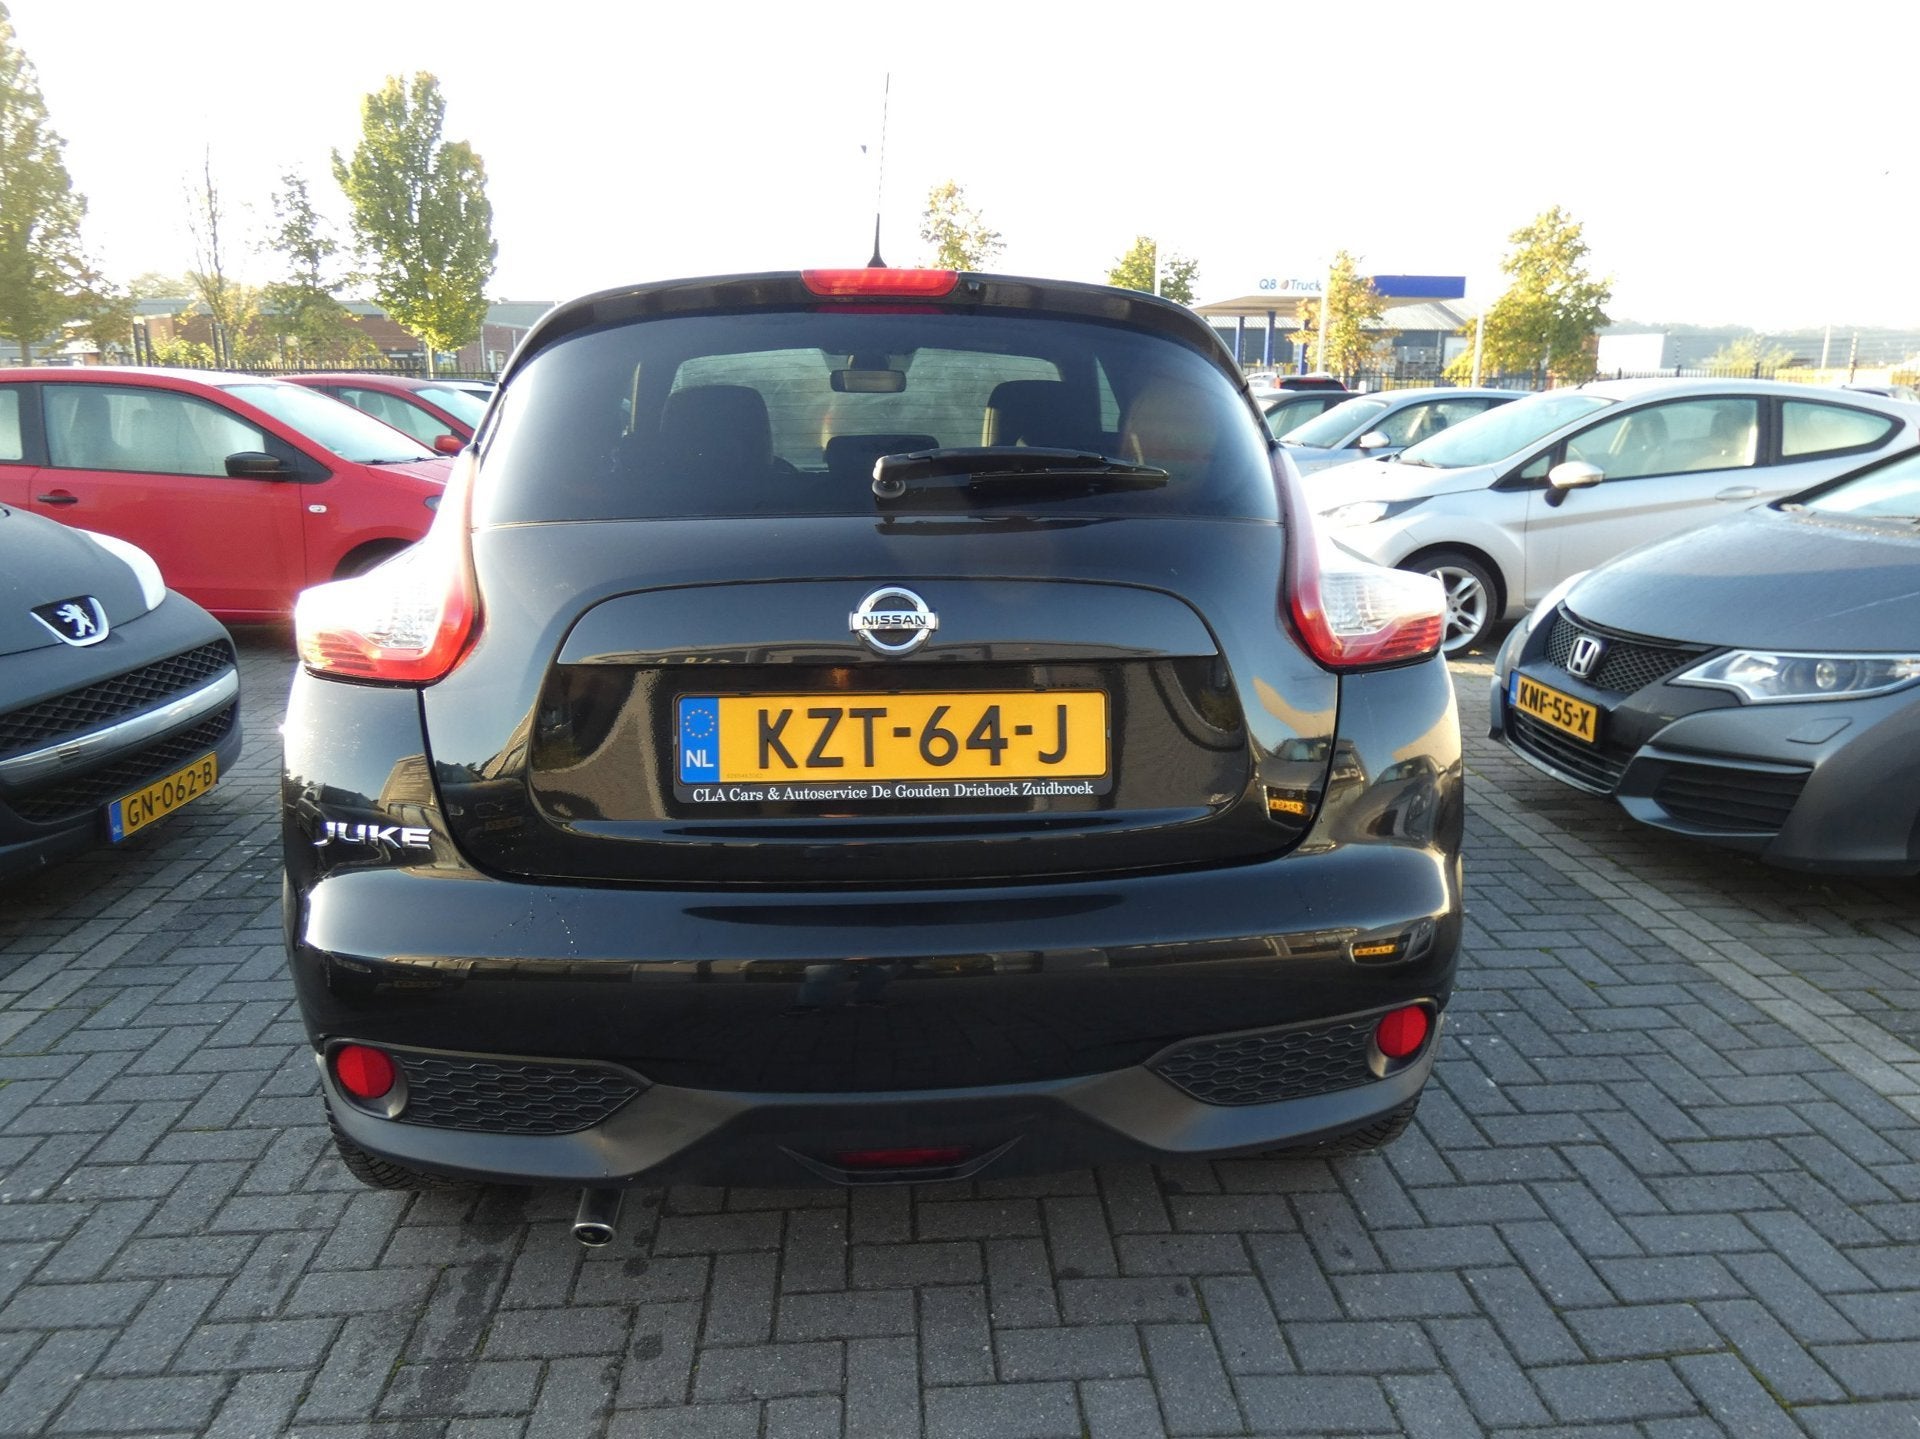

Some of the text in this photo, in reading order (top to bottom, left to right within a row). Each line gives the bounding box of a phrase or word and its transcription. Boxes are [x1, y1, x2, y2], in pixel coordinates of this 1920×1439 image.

[1259, 278, 1277, 290] Q8
[862, 615, 926, 625] NISSAN
[1520, 681, 1590, 735] KNF-55-X
[758, 704, 1068, 769] KZT-64-J
[685, 749, 714, 768] NL
[128, 761, 213, 827] GN-062-B
[693, 781, 1094, 802] CLA Cars & Autoservice De Gouden Driehoek Zuidbroek
[313, 821, 433, 850] JUKE
